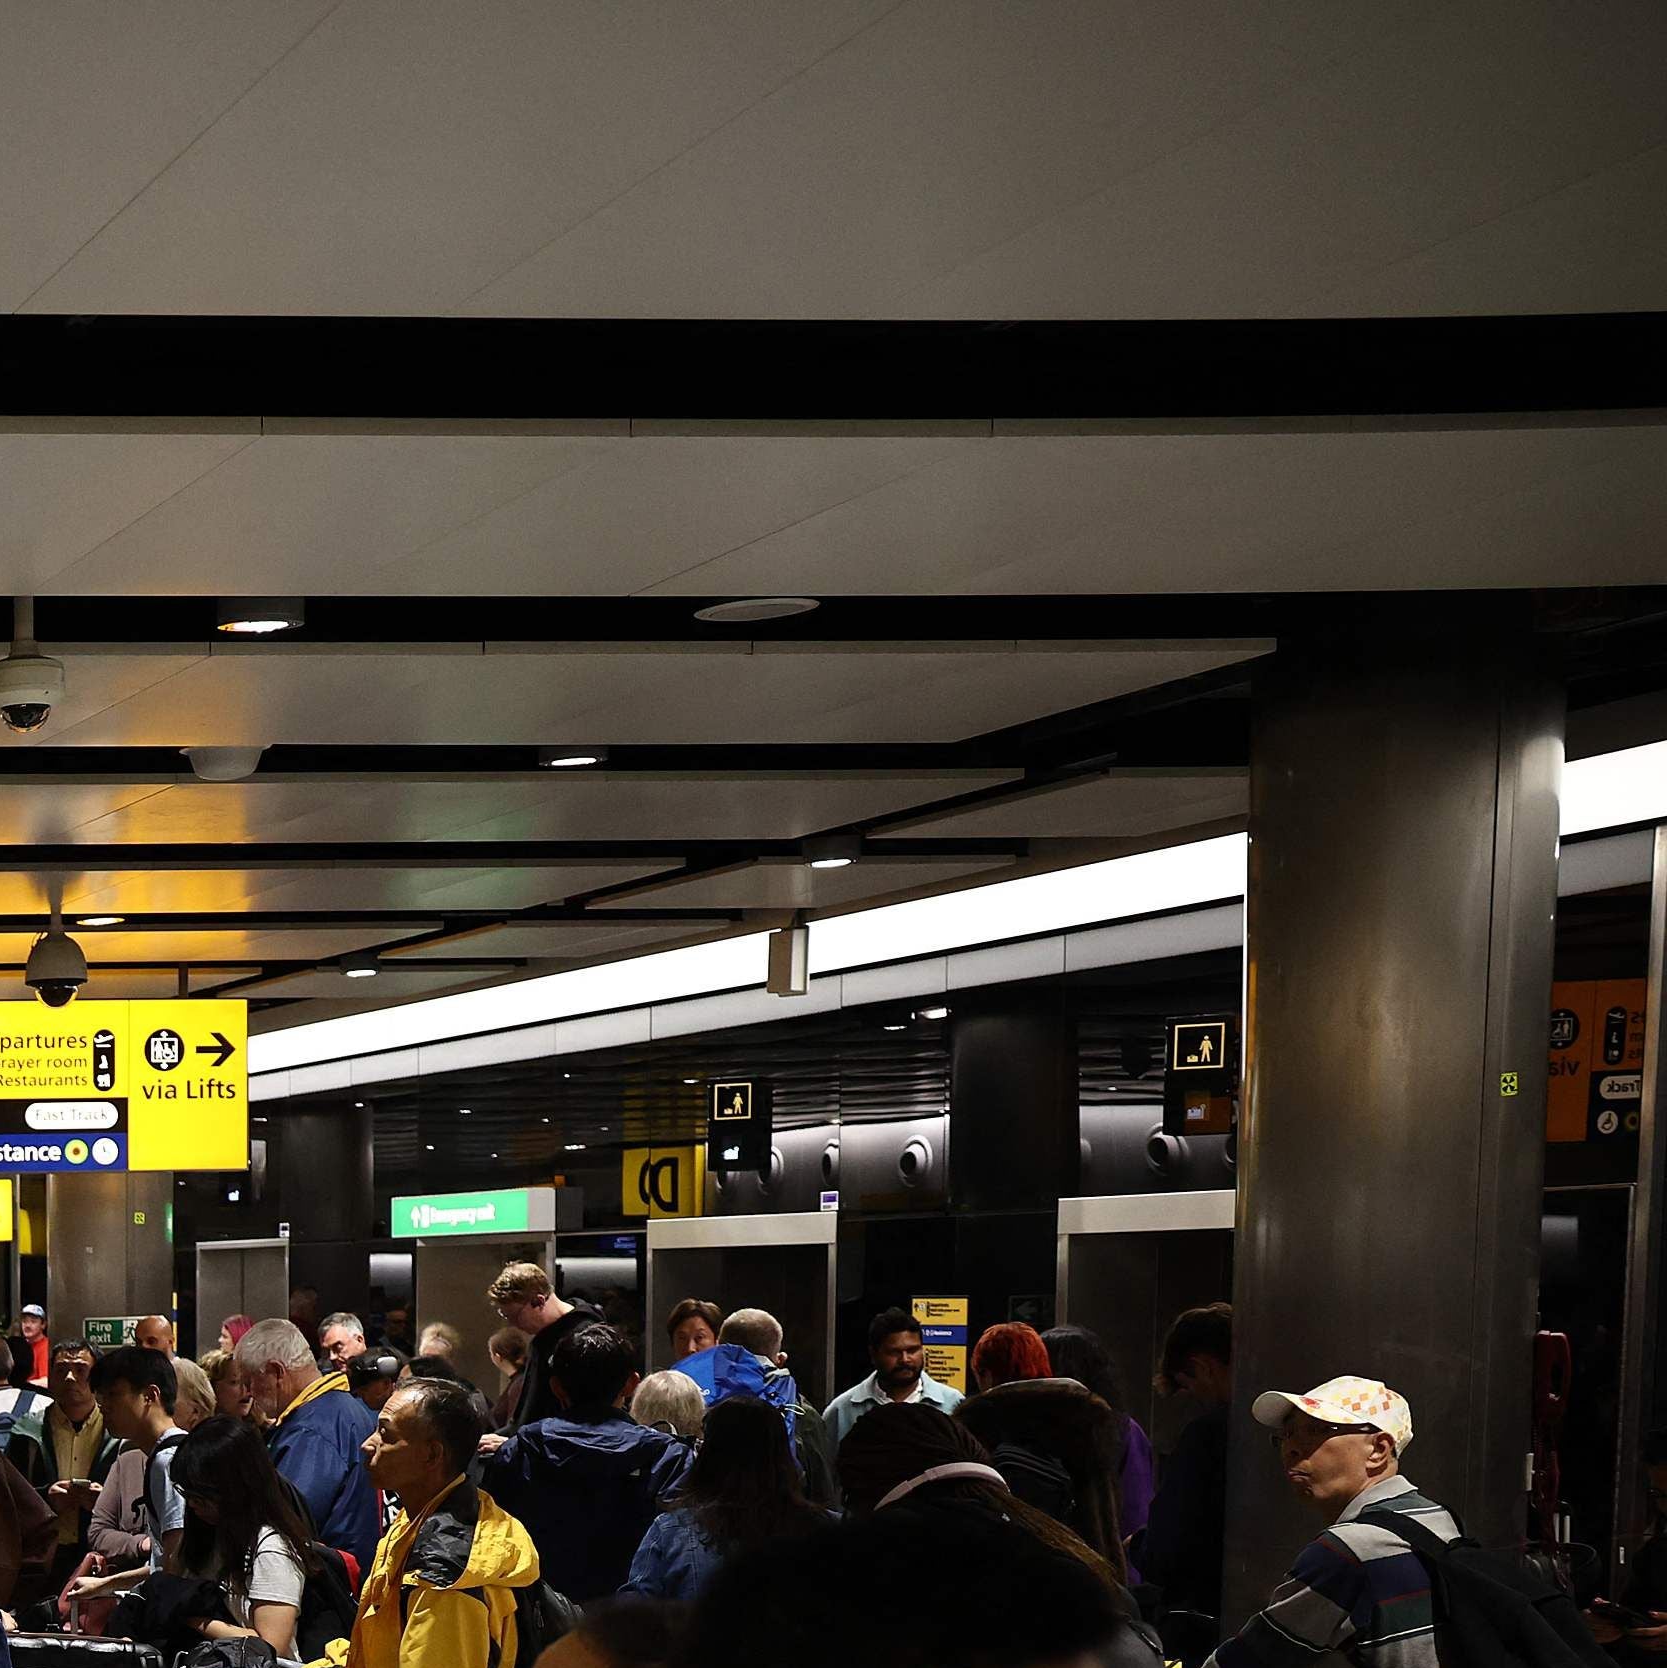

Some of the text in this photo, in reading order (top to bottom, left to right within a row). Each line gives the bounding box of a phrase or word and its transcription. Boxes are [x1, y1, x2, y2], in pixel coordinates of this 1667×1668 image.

[46, 1060, 88, 1069] room
[142, 1078, 237, 1100] via Lifts
[35, 1108, 109, 1121] Fast Track
[89, 1321, 112, 1332] Fire
[90, 1333, 111, 1343] exit
